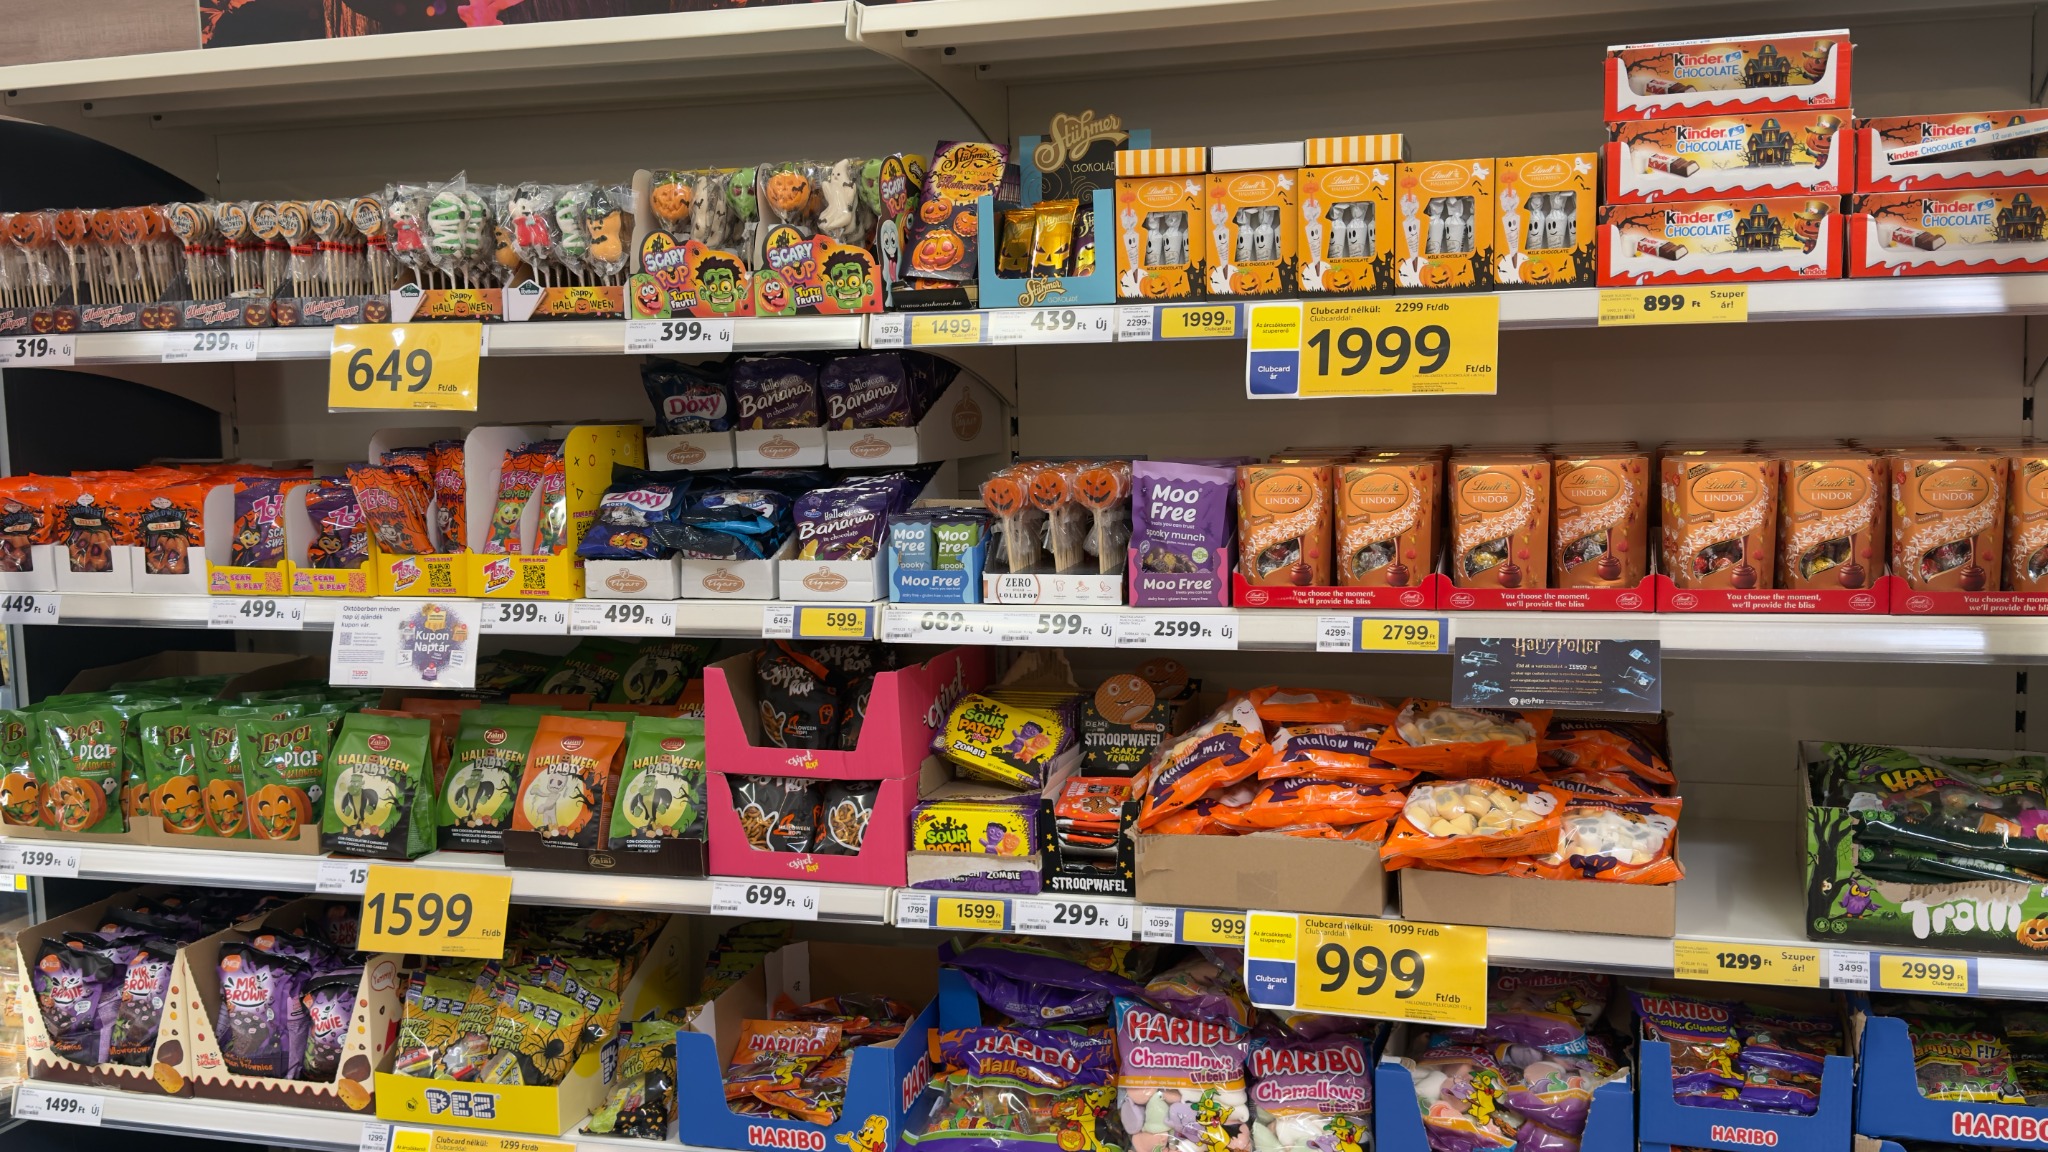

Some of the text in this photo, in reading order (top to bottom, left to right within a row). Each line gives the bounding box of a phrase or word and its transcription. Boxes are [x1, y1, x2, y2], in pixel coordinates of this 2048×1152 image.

[1033, 109, 1131, 174] Stühmer
[1677, 139, 1742, 153] CHOCOLATE
[1306, 171, 1314, 179] 4x
[645, 249, 685, 271] SCARY
[770, 244, 813, 268] SCARY
[449, 293, 472, 301] happy
[570, 290, 593, 299] happy
[796, 287, 821, 299] TUTTI
[797, 296, 823, 306] FRUTTI
[1643, 295, 1684, 311] 899
[1710, 290, 1745, 301] Szuper
[1310, 302, 1450, 315] Clubcard nélkül: 2299 Ft/db
[932, 319, 971, 334] 1499
[1032, 310, 1107, 331] 439 Ft Új
[1126, 319, 1148, 327] 2299
[661, 322, 730, 341] 399 Ft Új
[881, 326, 899, 334] 1979
[1307, 325, 1451, 376] 1999
[348, 348, 457, 393] 649 Ft/db
[1257, 366, 1291, 374] Clubcard
[1466, 364, 1491, 374] Ft/db
[761, 376, 801, 392] Halloween
[849, 376, 885, 392] Halloween
[740, 382, 814, 417] Bananas
[1152, 484, 1199, 504] Moo
[1705, 493, 1744, 502] LINDOR
[1811, 492, 1852, 501] LINDOR
[1151, 502, 1197, 522] Free
[894, 529, 925, 540] Moo
[1146, 529, 1205, 542] spooky munch
[901, 576, 961, 586] Moo Free
[1006, 578, 1031, 587] ZERO
[1144, 579, 1212, 590] Moo Free
[604, 605, 671, 625] 499 Ft Új
[773, 617, 788, 625] 649
[920, 612, 993, 634] 689 Ft Új
[1037, 614, 1112, 637] 599 Ft Új
[1154, 621, 1233, 638] 2599 Ft Új
[1325, 629, 1346, 637] 4299
[416, 631, 449, 643] Kupon
[414, 642, 450, 654] Naptár
[1512, 638, 1601, 658] Harry Potter
[60, 721, 104, 744] BOCI
[263, 725, 310, 752] BOCI
[954, 741, 986, 758] ZOMBIE
[1110, 747, 1136, 756] SCARY
[353, 763, 392, 777] PARTY
[547, 763, 581, 776] PARTY
[1159, 741, 1226, 785] Mallow mix
[22, 852, 53, 866] 1399
[67, 856, 76, 868] Új
[591, 857, 612, 866] Zaini
[987, 871, 1021, 880] ZOMBIE
[746, 885, 813, 909] 699 Ft Új
[367, 893, 501, 938] 1599 Ft/db
[908, 906, 924, 914] 1799
[1053, 904, 1128, 928] 299 Ft Új
[1150, 920, 1169, 928] 1099
[1305, 919, 1439, 937] Clubcard nélkül: 1099 Ft/db
[1716, 953, 1761, 970] 1299
[1764, 959, 1771, 967] Ft
[1782, 952, 1816, 964] Szuper
[1838, 963, 1863, 973] 3499
[1317, 943, 1425, 999] 999
[236, 977, 257, 989] MR
[1256, 975, 1287, 984] Clubcard
[423, 996, 465, 1016] PEZ
[1436, 993, 1461, 1003] Ft/db
[518, 999, 562, 1026] PEZ
[1641, 998, 1729, 1021] HARIBO
[463, 1012, 491, 1024] HALLO
[496, 1018, 525, 1030] HAPPY
[750, 1035, 825, 1053] HARIBO
[976, 1034, 1082, 1075] HARIBO
[1130, 1049, 1233, 1070] Chamallows
[1254, 1047, 1364, 1077] HARIBO
[46, 1097, 99, 1116] 1499 Ft Új
[426, 1089, 496, 1119] PEZ
[368, 1134, 383, 1142] 1299
[436, 1136, 538, 1151] Clubcard nélkül: 1299 Ft/db
[749, 1125, 825, 1150] HARIBO
[1712, 1125, 1778, 1146] HARIBO
